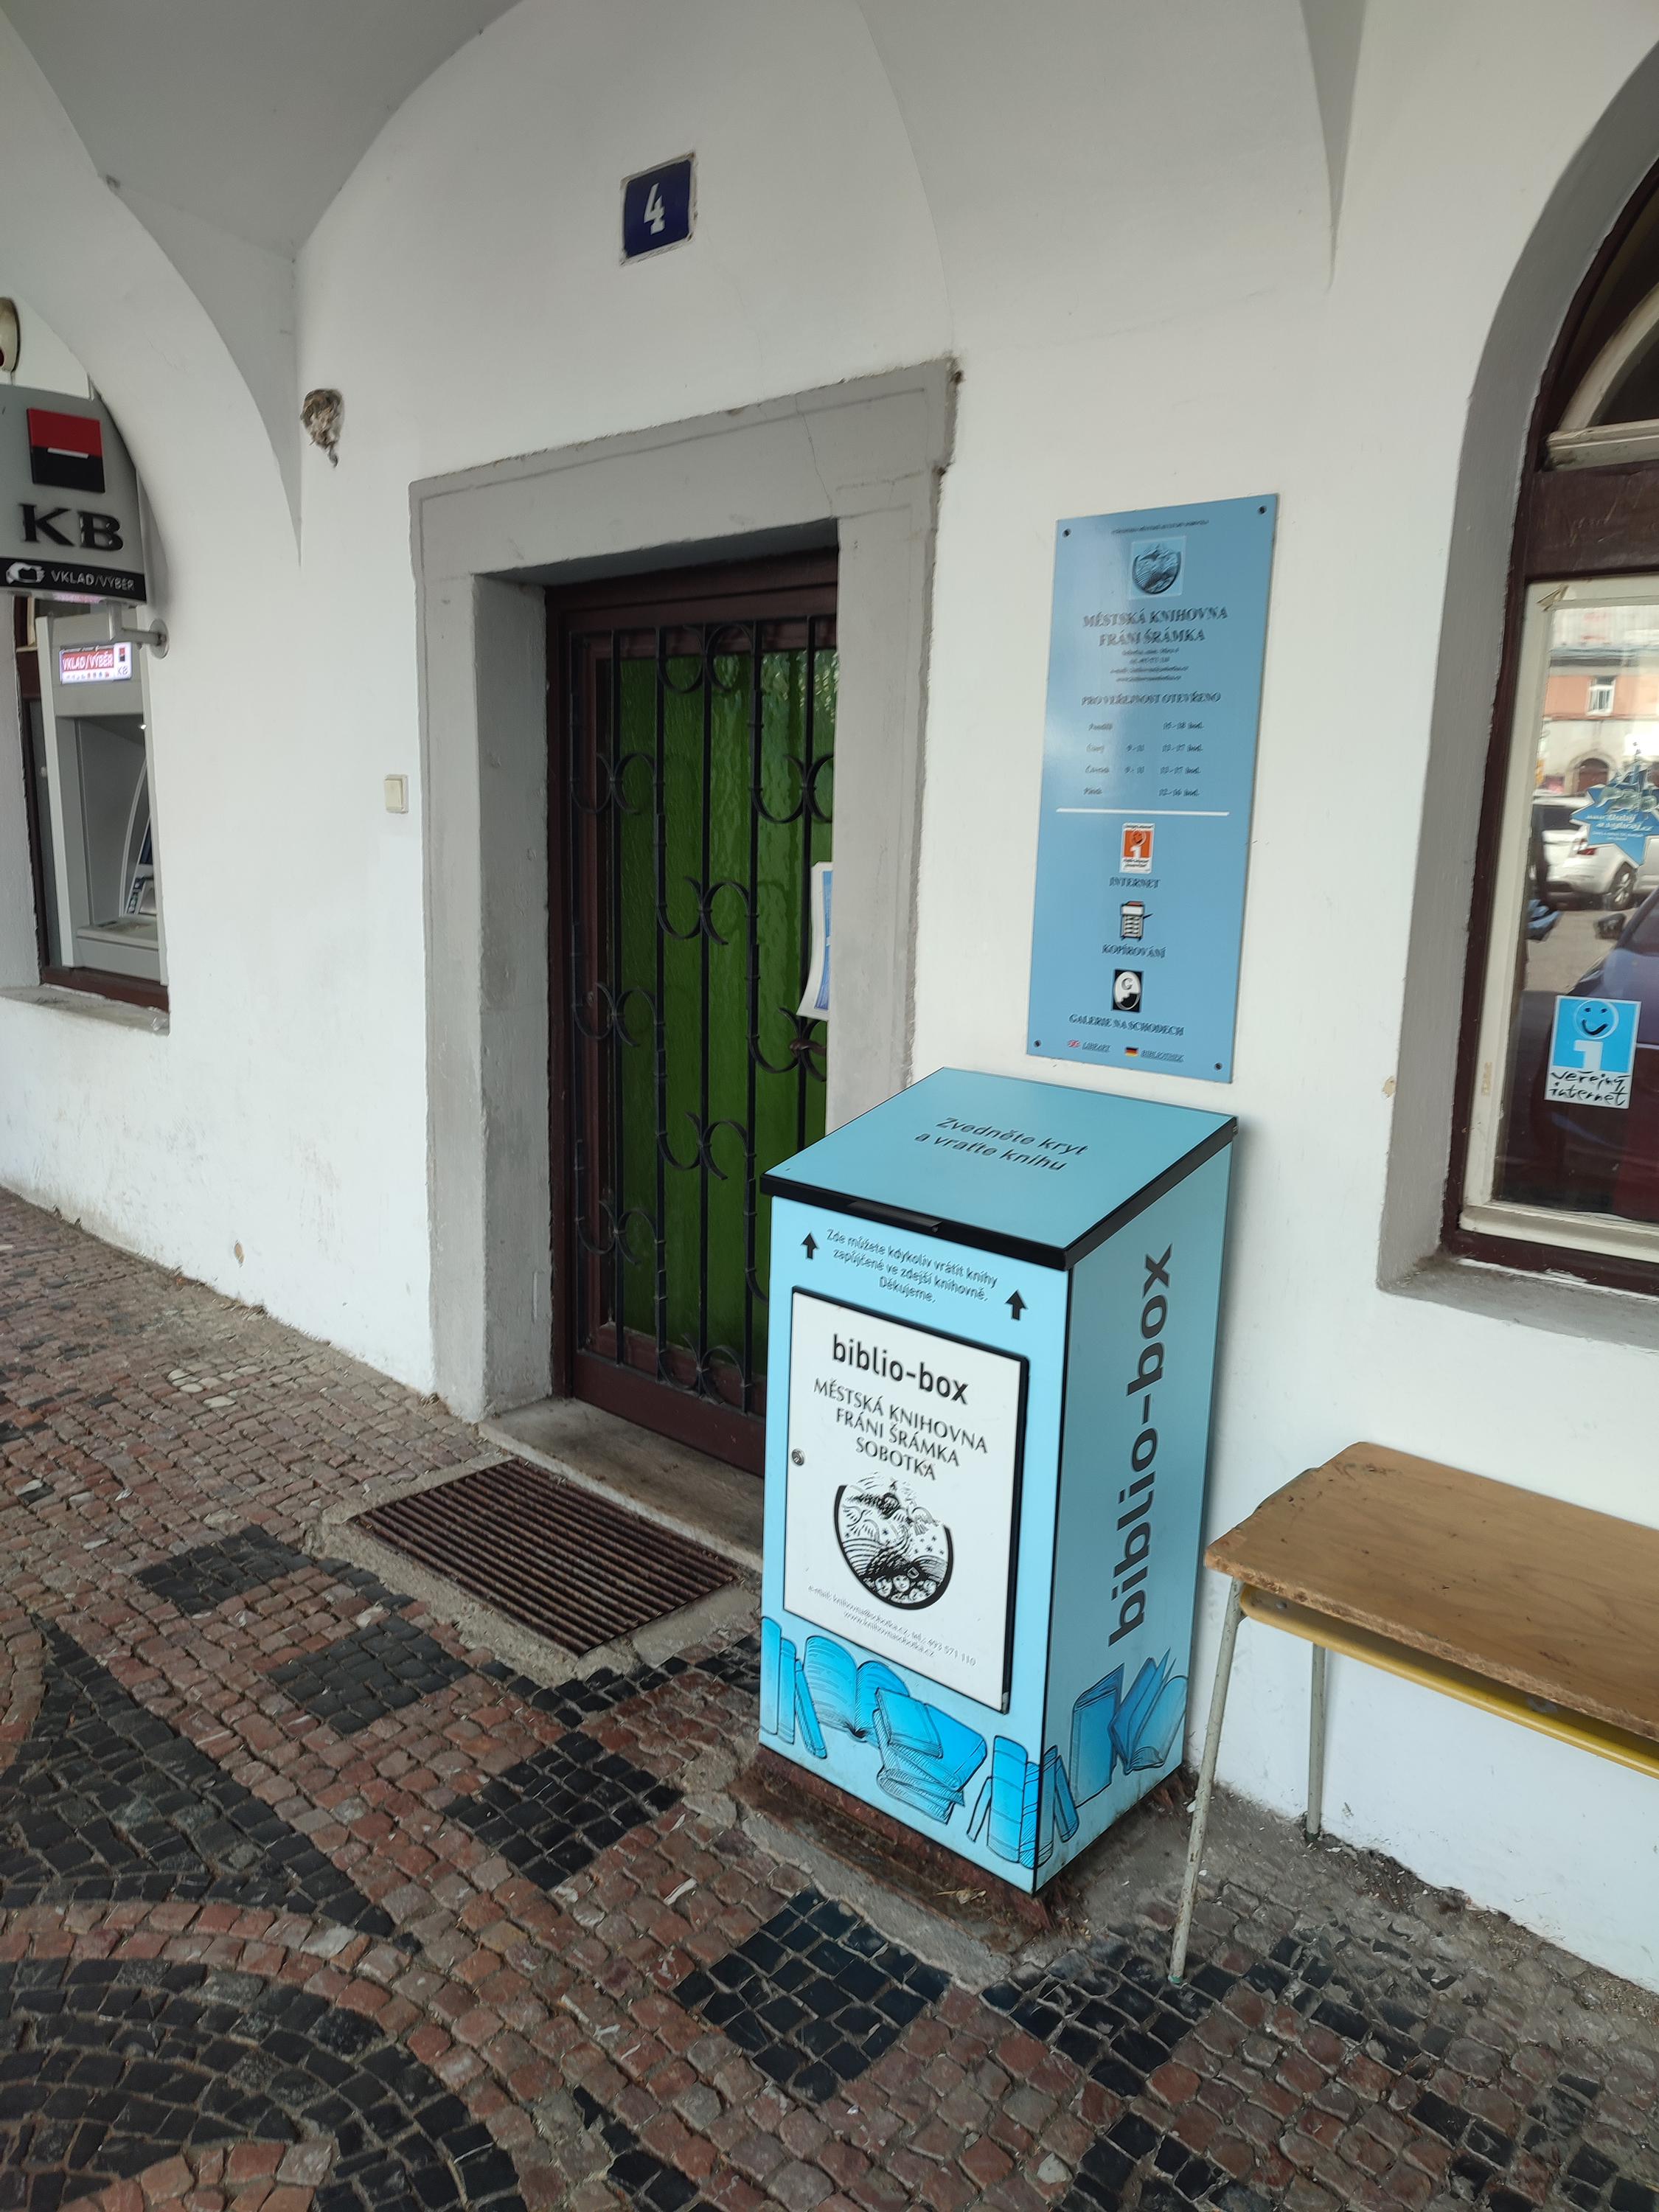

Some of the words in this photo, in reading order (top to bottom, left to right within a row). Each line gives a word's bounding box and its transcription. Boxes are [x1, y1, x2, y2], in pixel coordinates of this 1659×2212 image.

[644, 182, 666, 235] 4
[18, 502, 124, 552] KB
[1082, 608, 1146, 627] MĚSTSKÁ
[1150, 606, 1228, 623] KNIHOVNA
[1099, 630, 1140, 646] FRÁNI
[1143, 627, 1206, 644] ŠRÁMKA
[1109, 877, 1160, 888] INTERNET
[1102, 944, 1166, 959] KOPÍROVÁNÍ
[1069, 1014, 1113, 1027] GALERIE
[1127, 1021, 1185, 1036] SCHODECH
[1548, 1082, 1628, 1106] internet
[1551, 1071, 1630, 1092] veřejný
[914, 1133, 931, 1142] a
[933, 1136, 998, 1156] vraťte
[999, 1149, 1068, 1171] knihu
[935, 1116, 1036, 1145] Zvedněte
[1037, 1138, 1089, 1155] kryt
[827, 1228, 846, 1244] Zde
[847, 1236, 886, 1255] můžete
[888, 1245, 932, 1268] kdykoliv
[933, 1261, 964, 1277] vrátit
[966, 1267, 998, 1288] knihy
[833, 1248, 885, 1271] zapůjčené
[886, 1263, 898, 1275] ve
[900, 1267, 932, 1285] zdejší
[832, 1333, 969, 1405] biblio-box
[813, 1377, 884, 1416] MĚSTSKÁ
[889, 1404, 988, 1454] KNIHOVNA
[835, 1407, 883, 1439] FRÁNI
[888, 1422, 960, 1467] ŠRÁMKA
[1107, 1243, 1173, 1648] biblio-box
[855, 1436, 936, 1481] SOBOTKA
